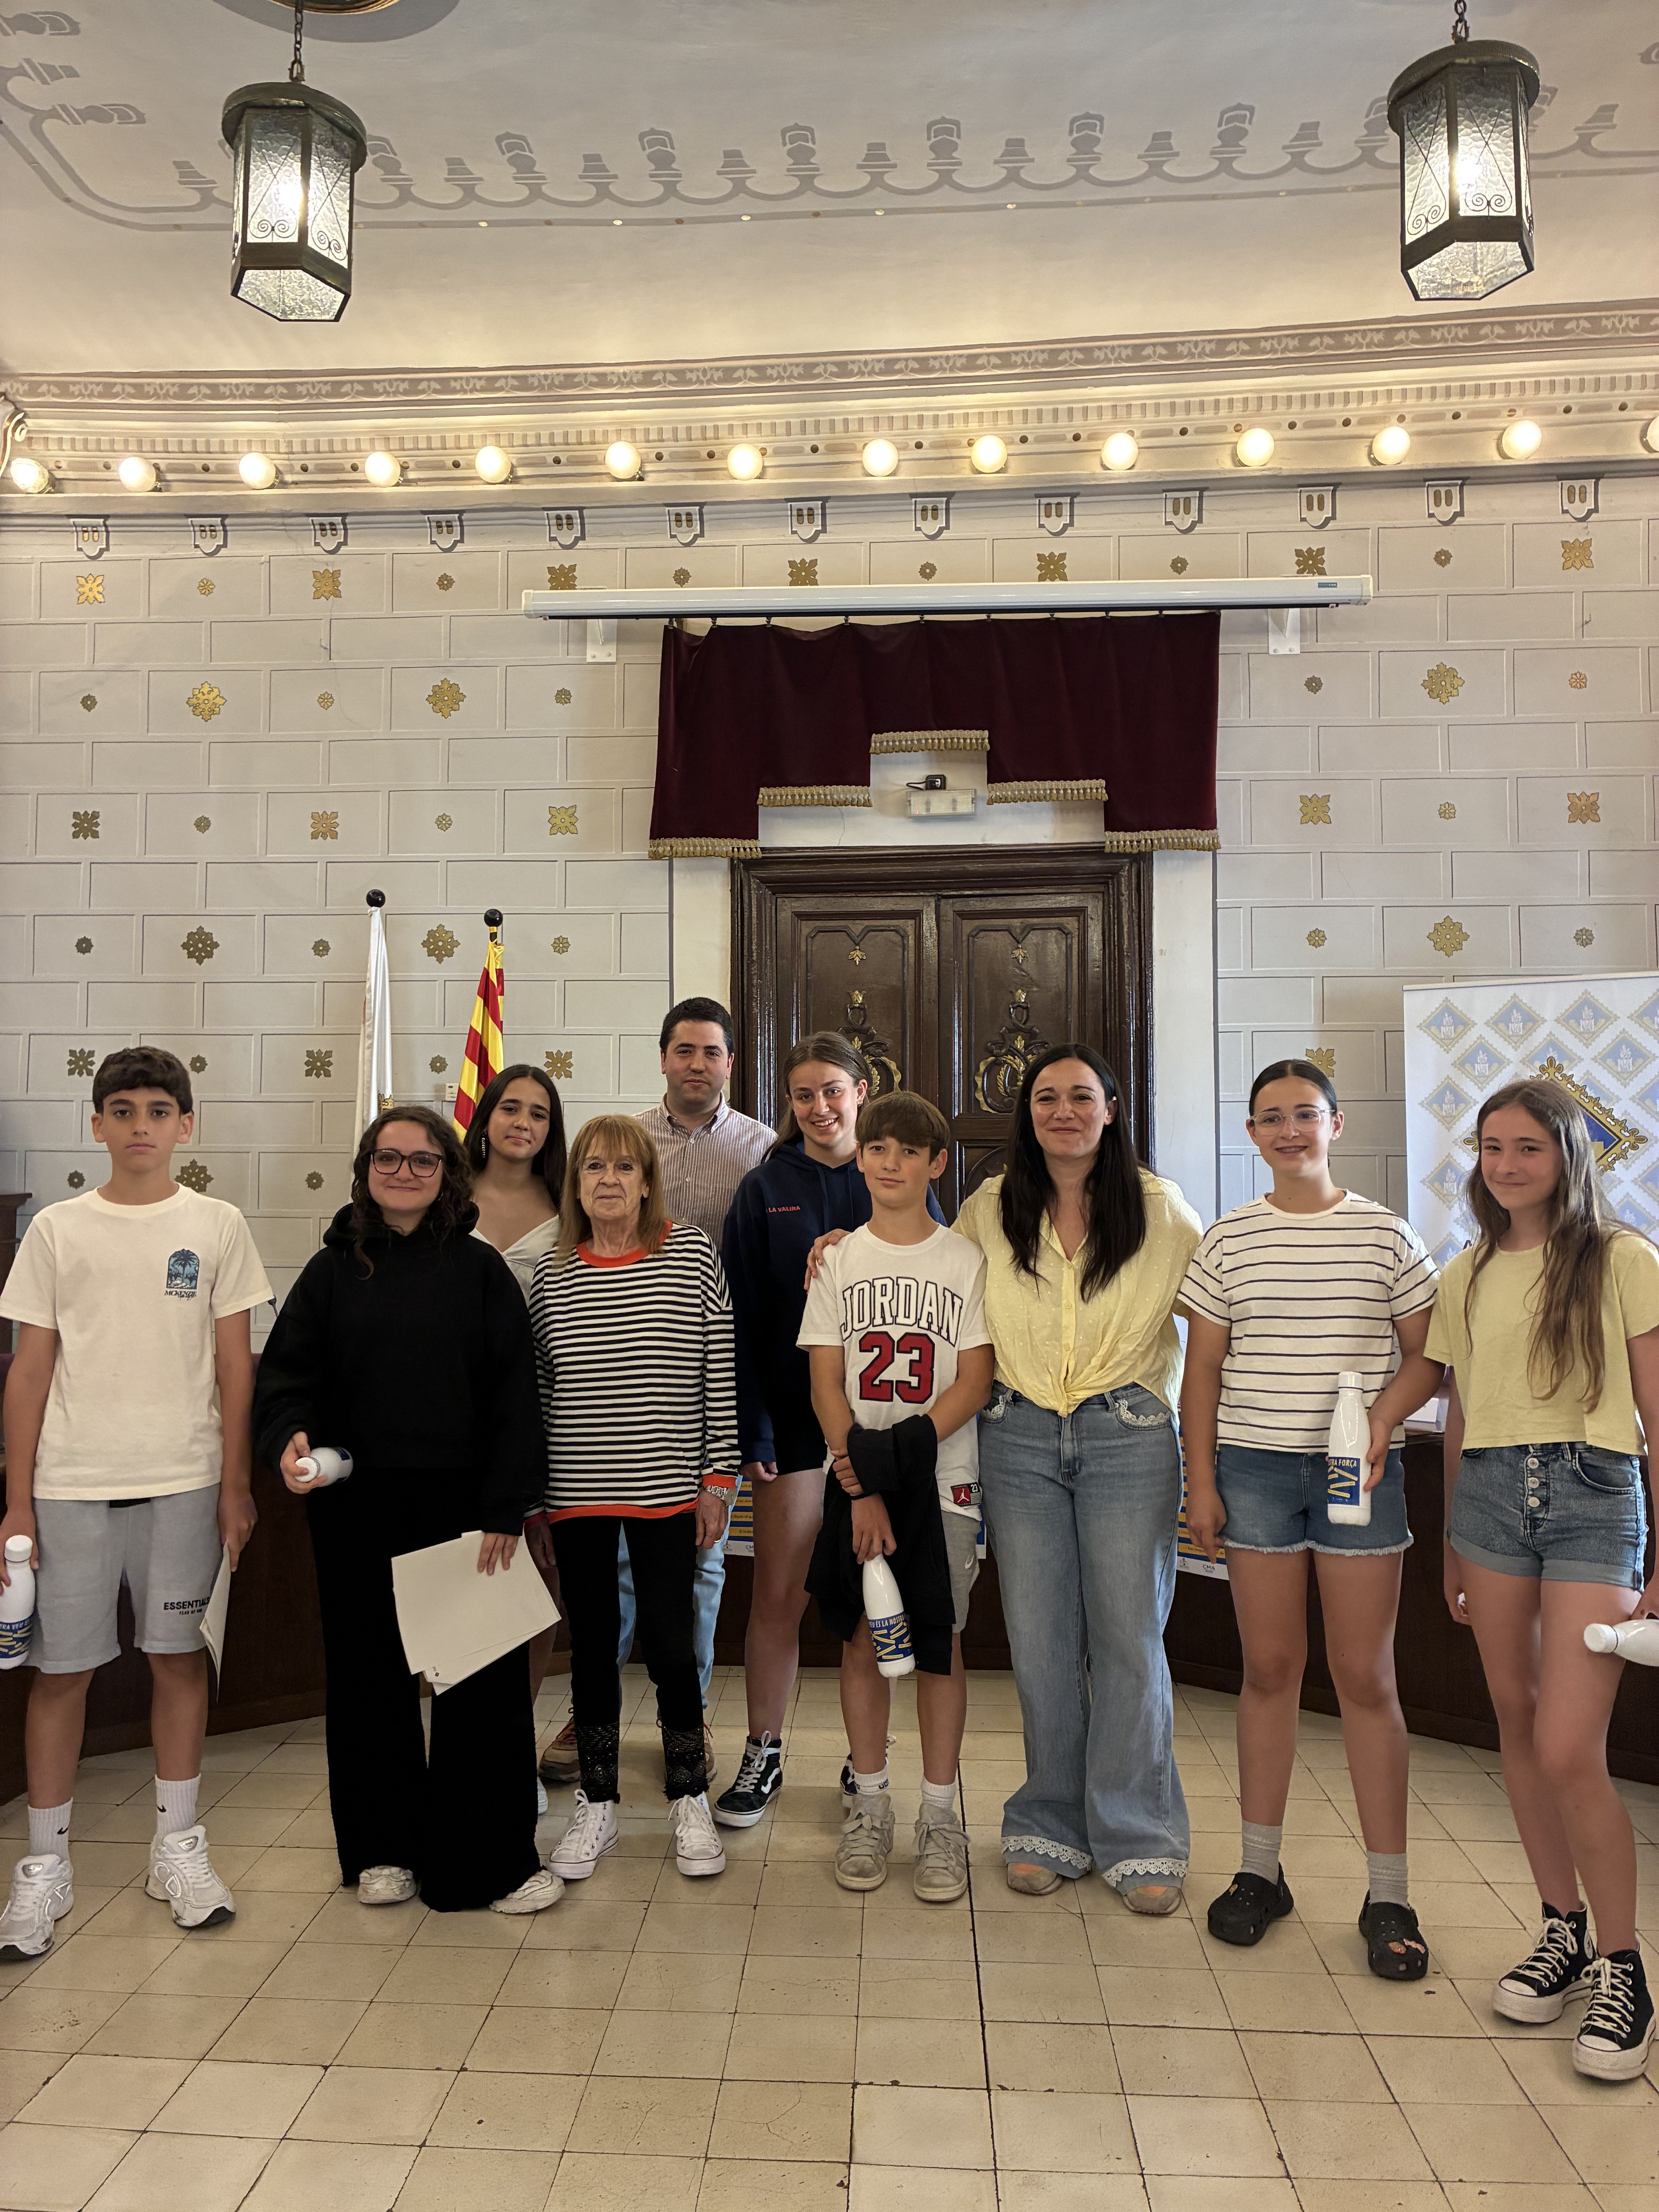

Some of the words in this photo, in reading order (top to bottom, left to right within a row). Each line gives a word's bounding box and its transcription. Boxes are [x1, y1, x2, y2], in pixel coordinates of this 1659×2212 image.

[840, 1276, 963, 1347] JORDAN
[859, 1331, 935, 1404] 23
[1339, 1459, 1357, 1468] FORÇA
[970, 1484, 978, 1492] 23
[164, 1596, 211, 1610] ESSENTIALS
